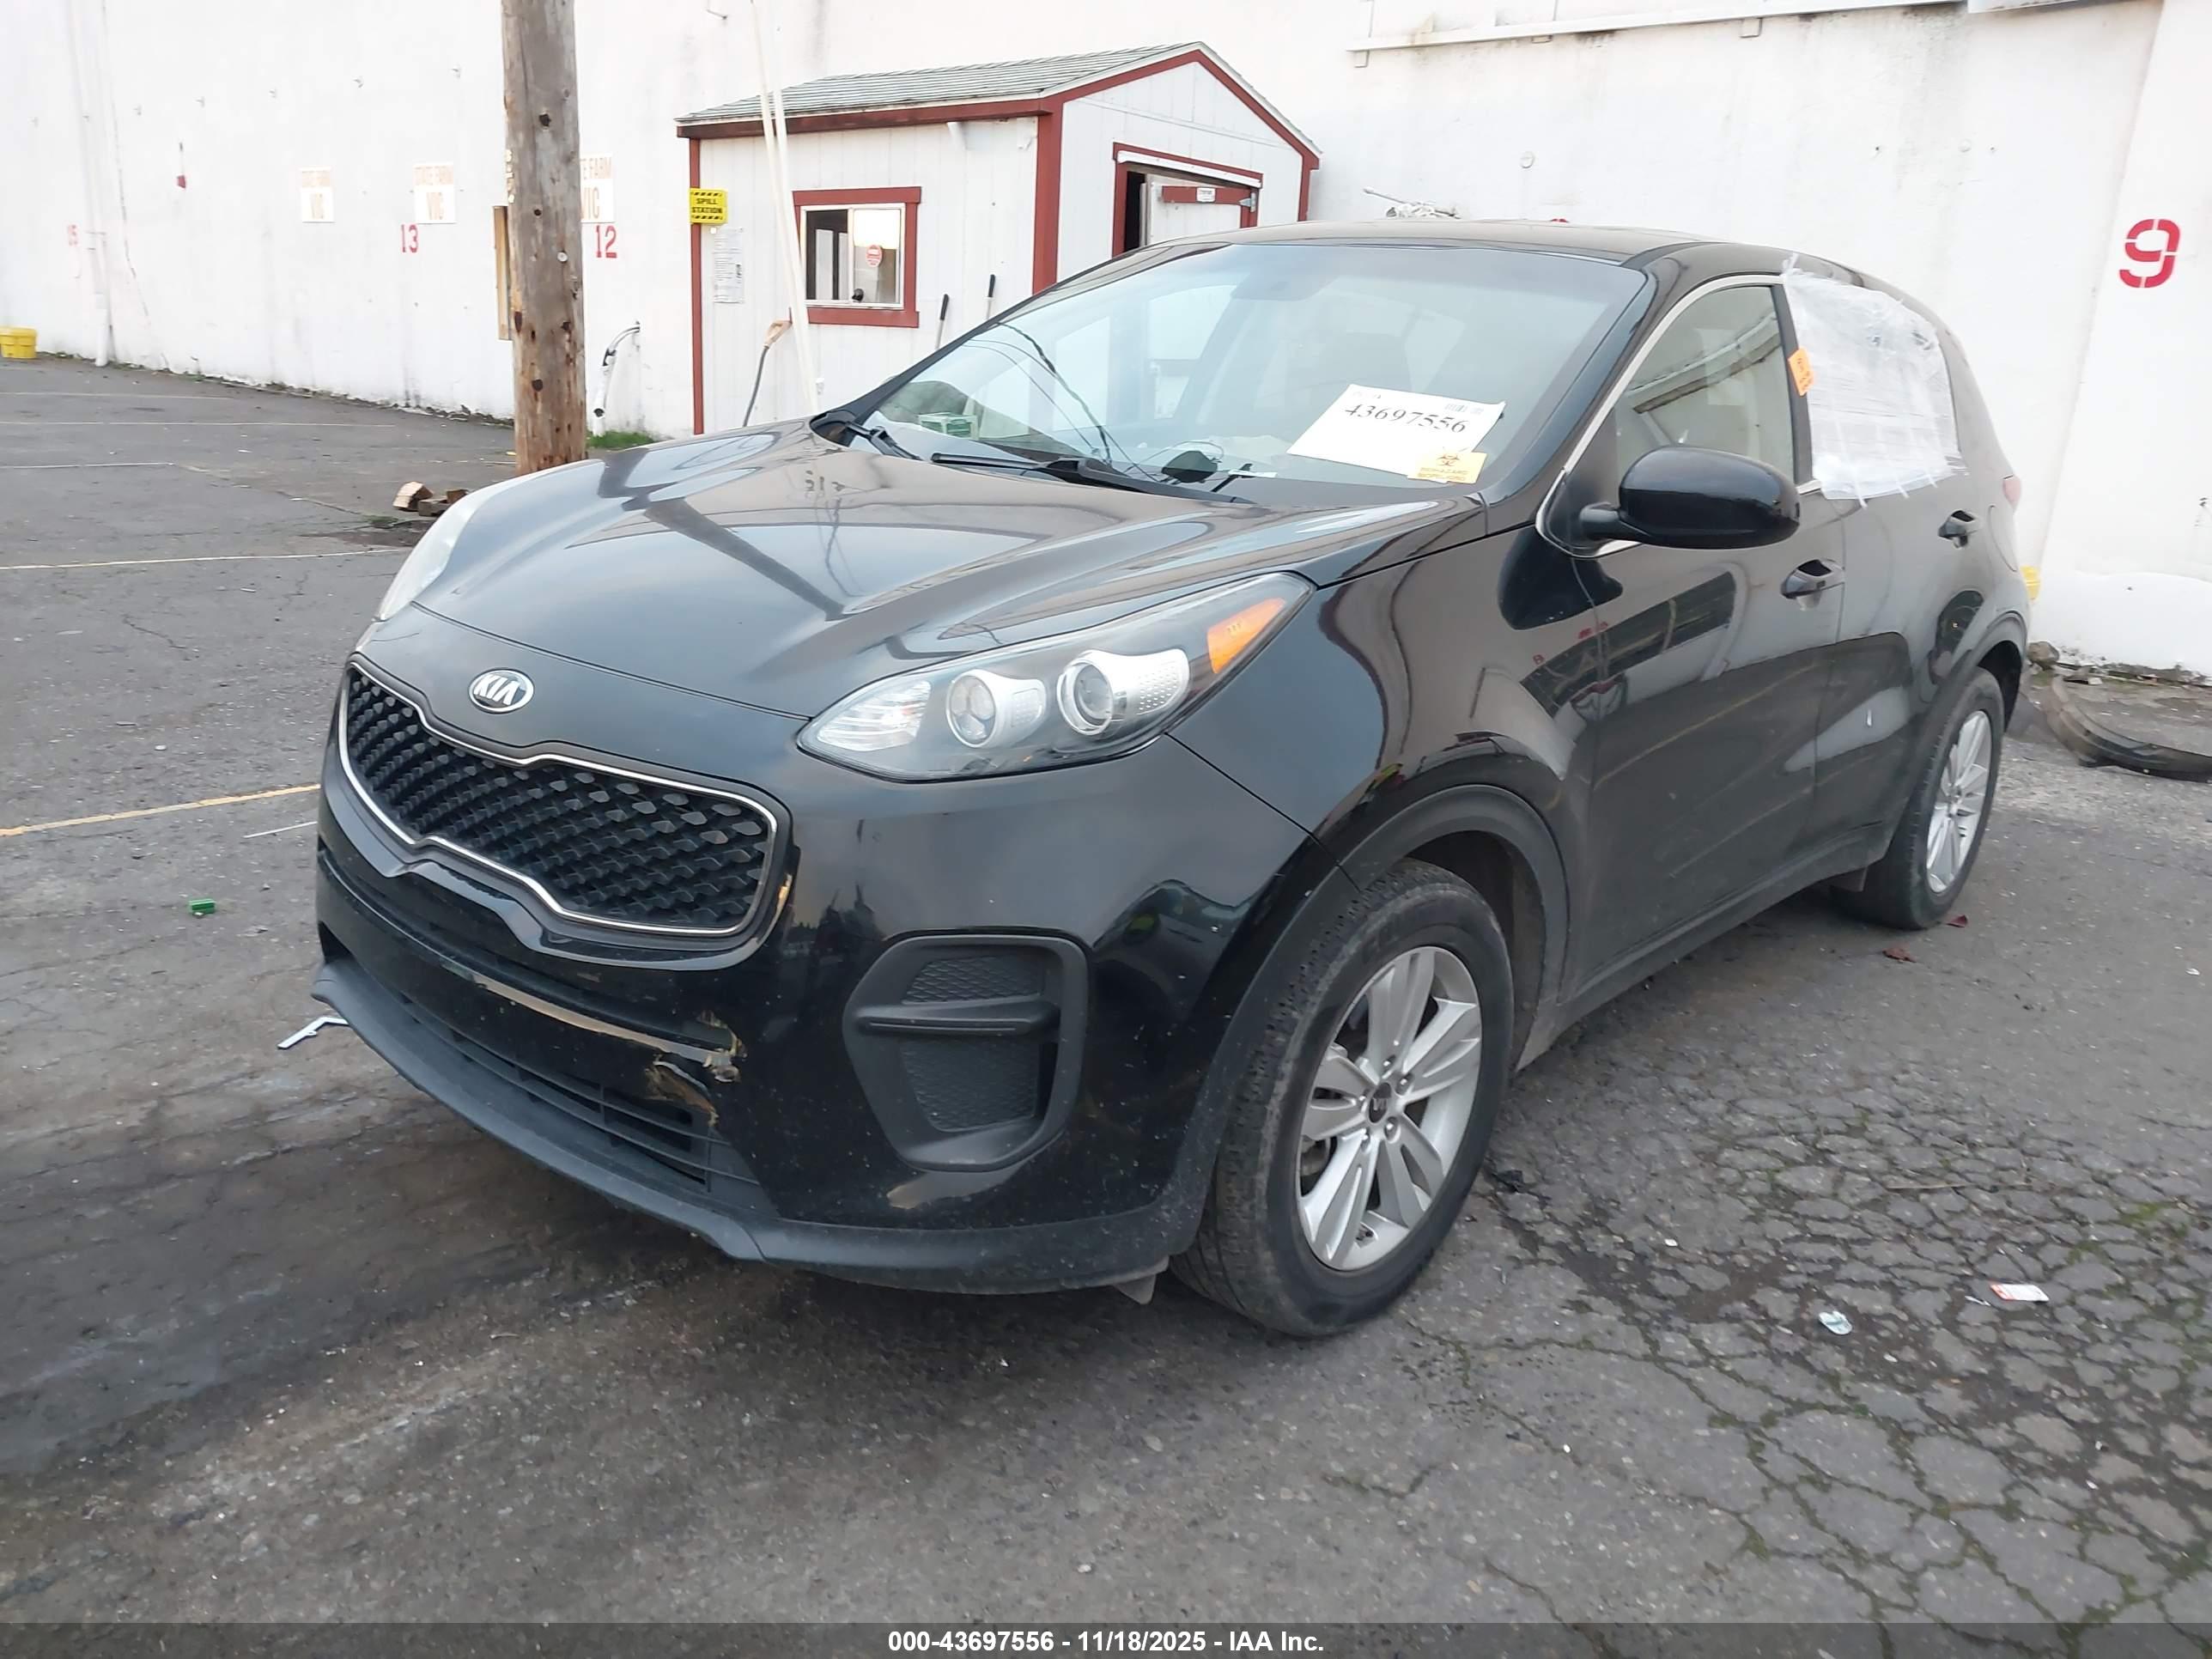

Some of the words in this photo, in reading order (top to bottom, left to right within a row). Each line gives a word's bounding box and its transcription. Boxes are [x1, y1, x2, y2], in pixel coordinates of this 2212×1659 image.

[401, 224, 419, 253] 13
[596, 225, 617, 258] 12
[2119, 219, 2180, 289] 9
[1345, 403, 1469, 433] 43697556
[473, 673, 521, 706] KIA
